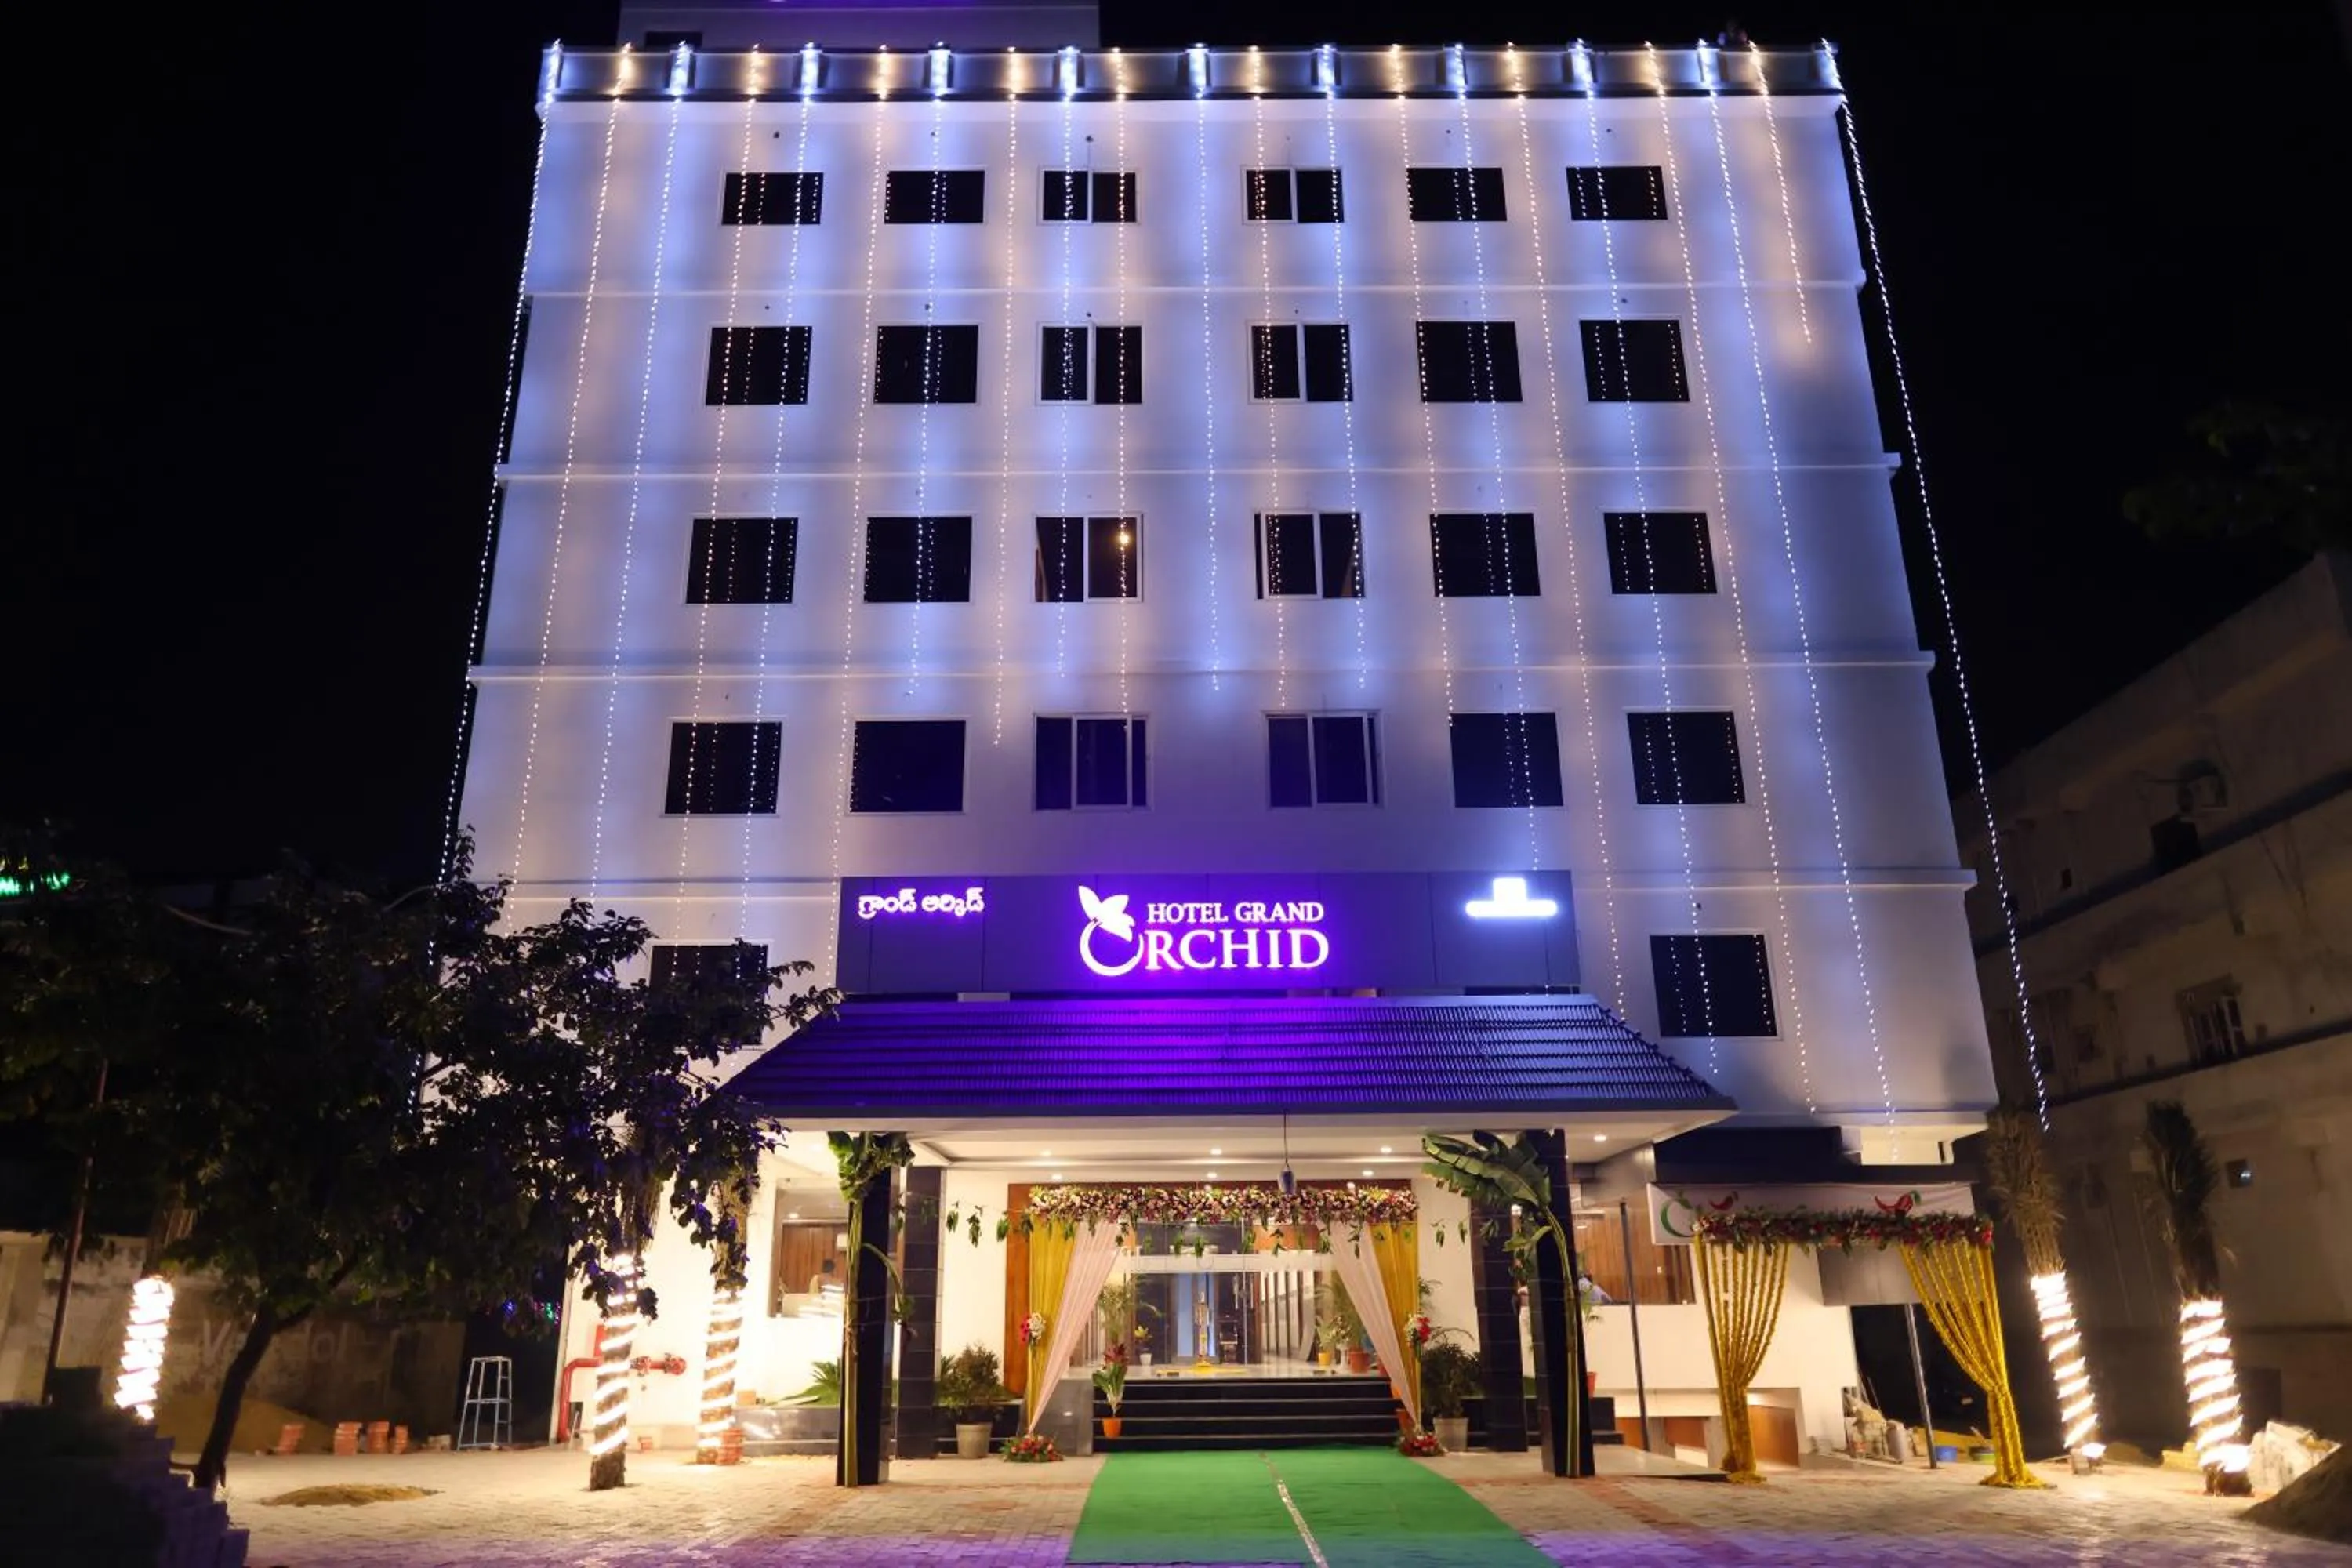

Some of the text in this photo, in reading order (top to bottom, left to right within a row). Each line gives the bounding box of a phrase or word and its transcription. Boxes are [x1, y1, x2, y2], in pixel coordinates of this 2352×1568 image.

[858, 888, 917, 919] గ్రాండ్
[1146, 902, 1325, 924] HOTEL GRAND
[1079, 917, 1330, 977] ORCHID
